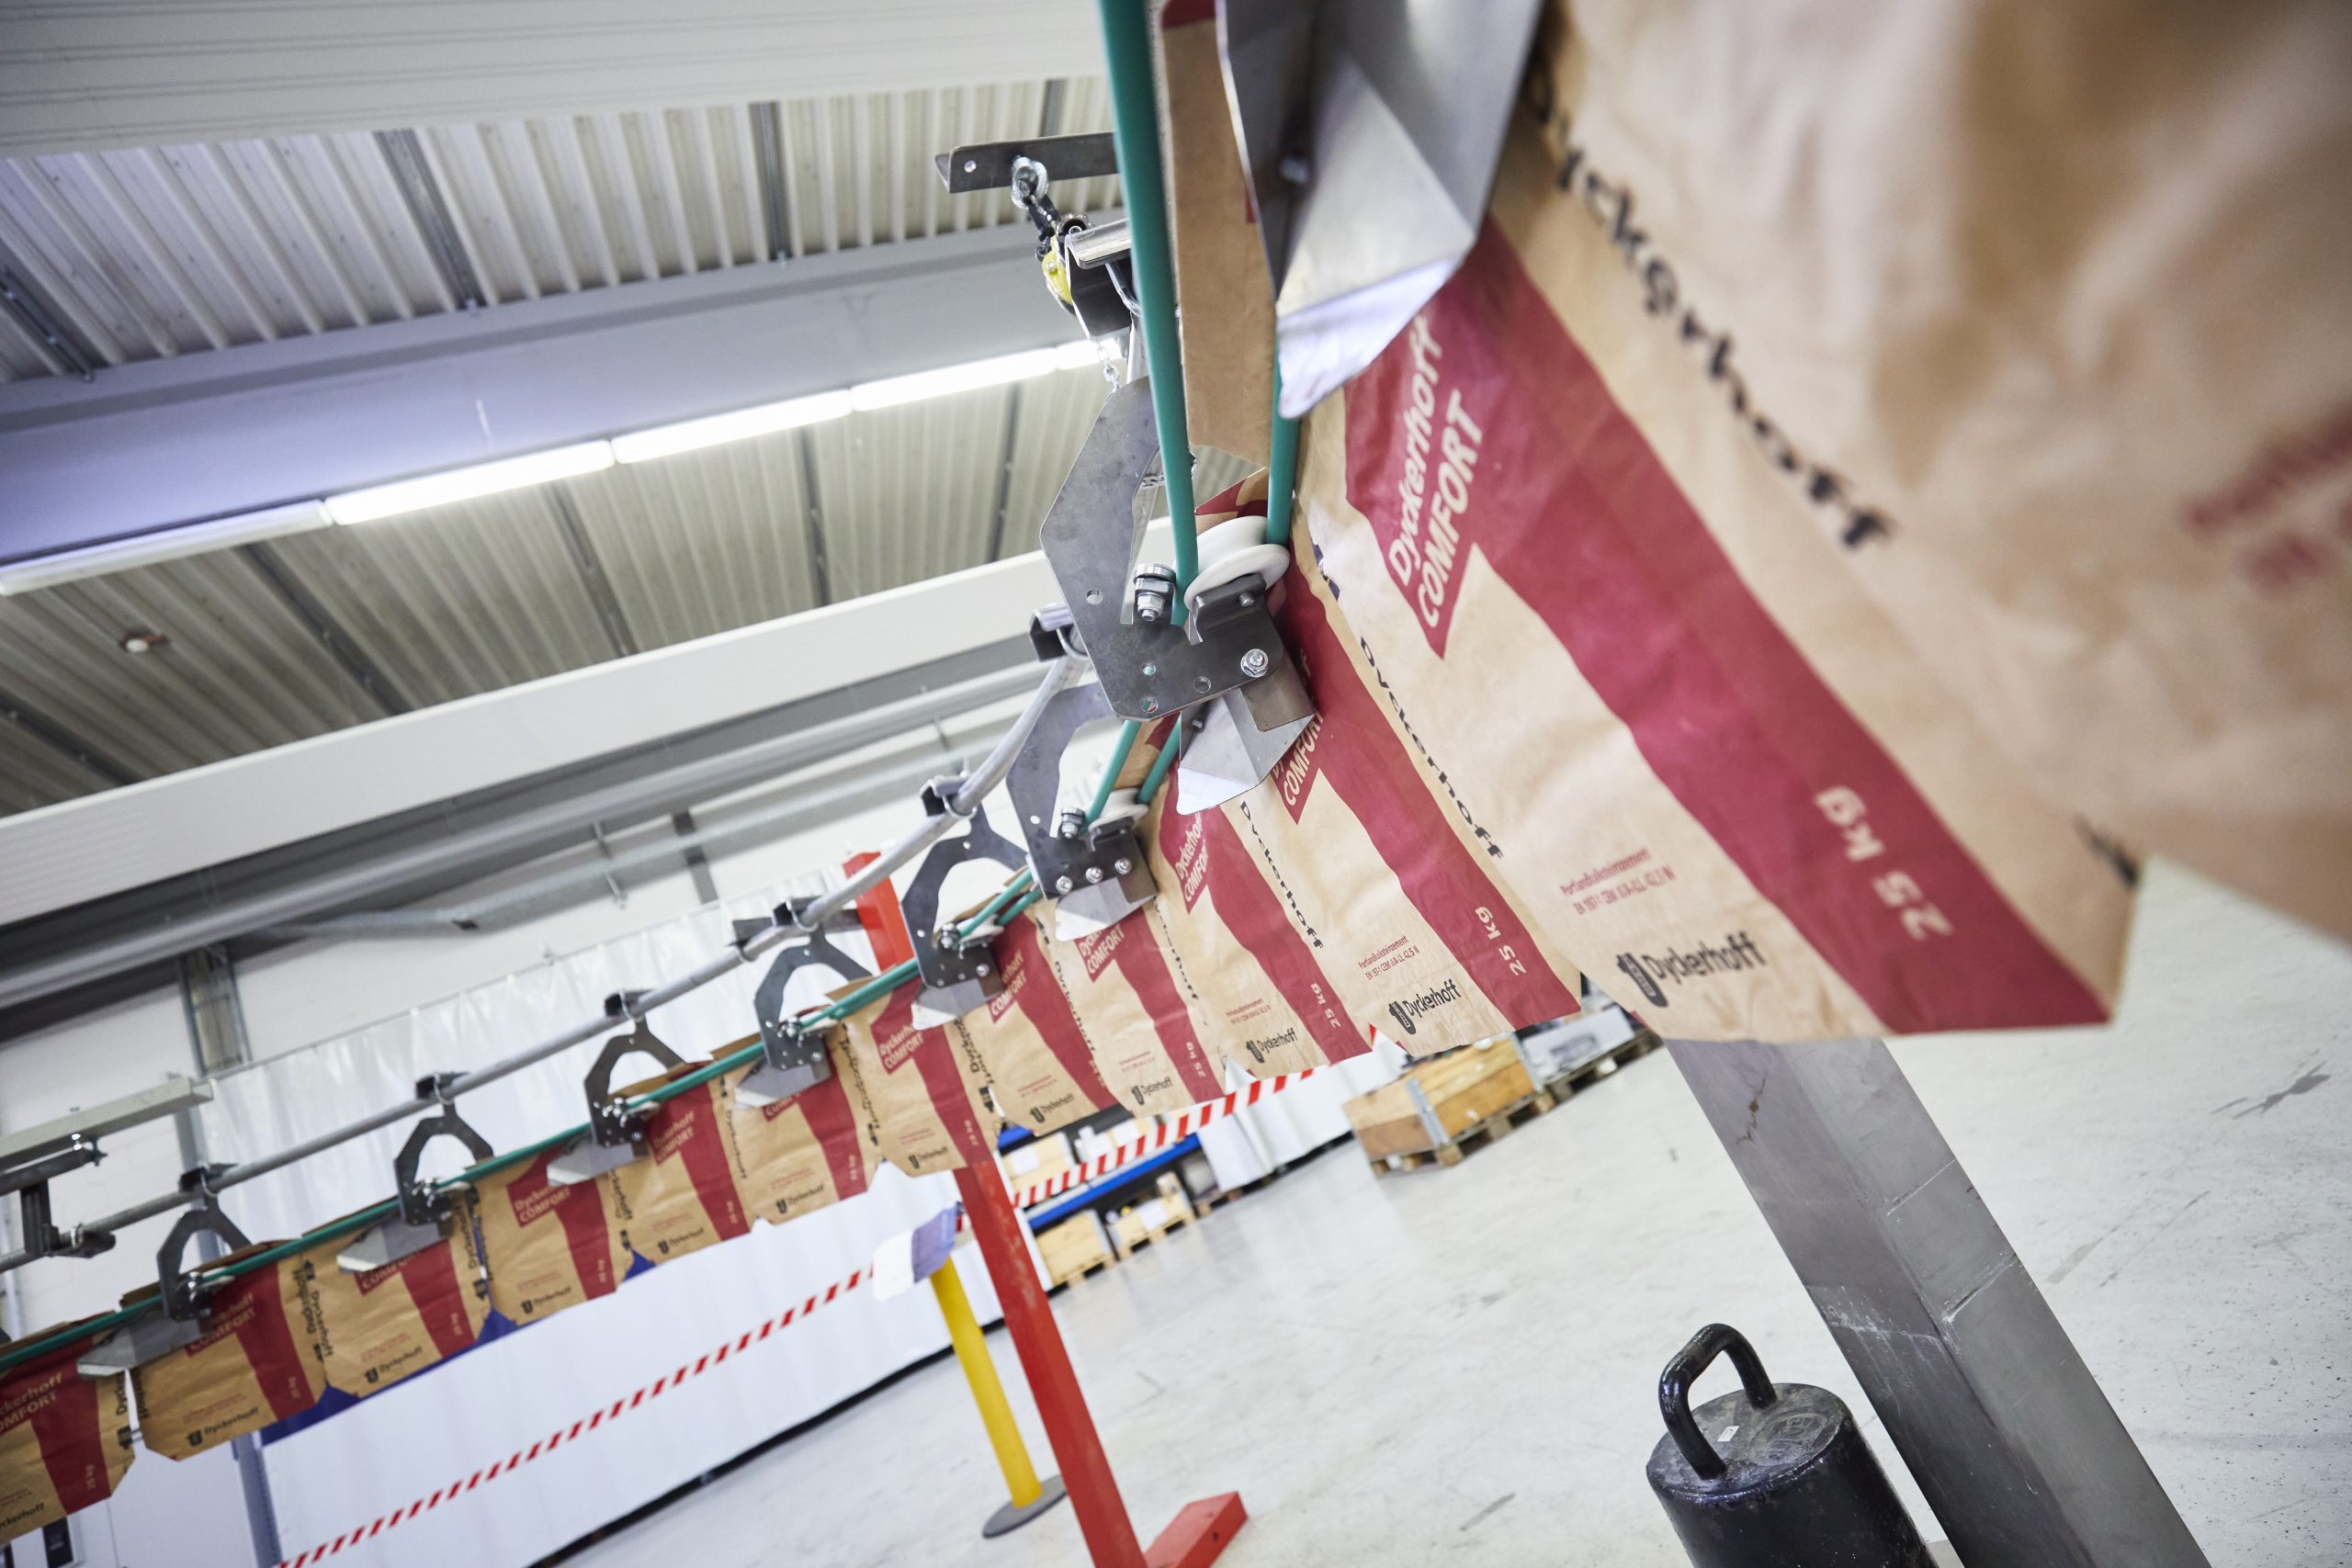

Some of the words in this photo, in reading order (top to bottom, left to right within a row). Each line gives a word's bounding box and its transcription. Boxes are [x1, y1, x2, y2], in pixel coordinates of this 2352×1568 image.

[1388, 312, 1443, 586] Dyckerhoff
[1418, 386, 1484, 629] COMFORT
[1813, 784, 1886, 863] kg
[1240, 800, 1324, 950] Dyckerhoff
[1474, 906, 1501, 940] kg
[1871, 869, 1956, 942] 25
[1086, 922, 1125, 975] COMFORT
[1498, 943, 1527, 976] 25
[991, 969, 1027, 1016] COMFORT
[1310, 983, 1327, 1005] kg
[1402, 978, 1463, 1019] Dyckerhoff
[1256, 1027, 1299, 1055] Dyckerhoff
[1324, 1008, 1341, 1029] 25
